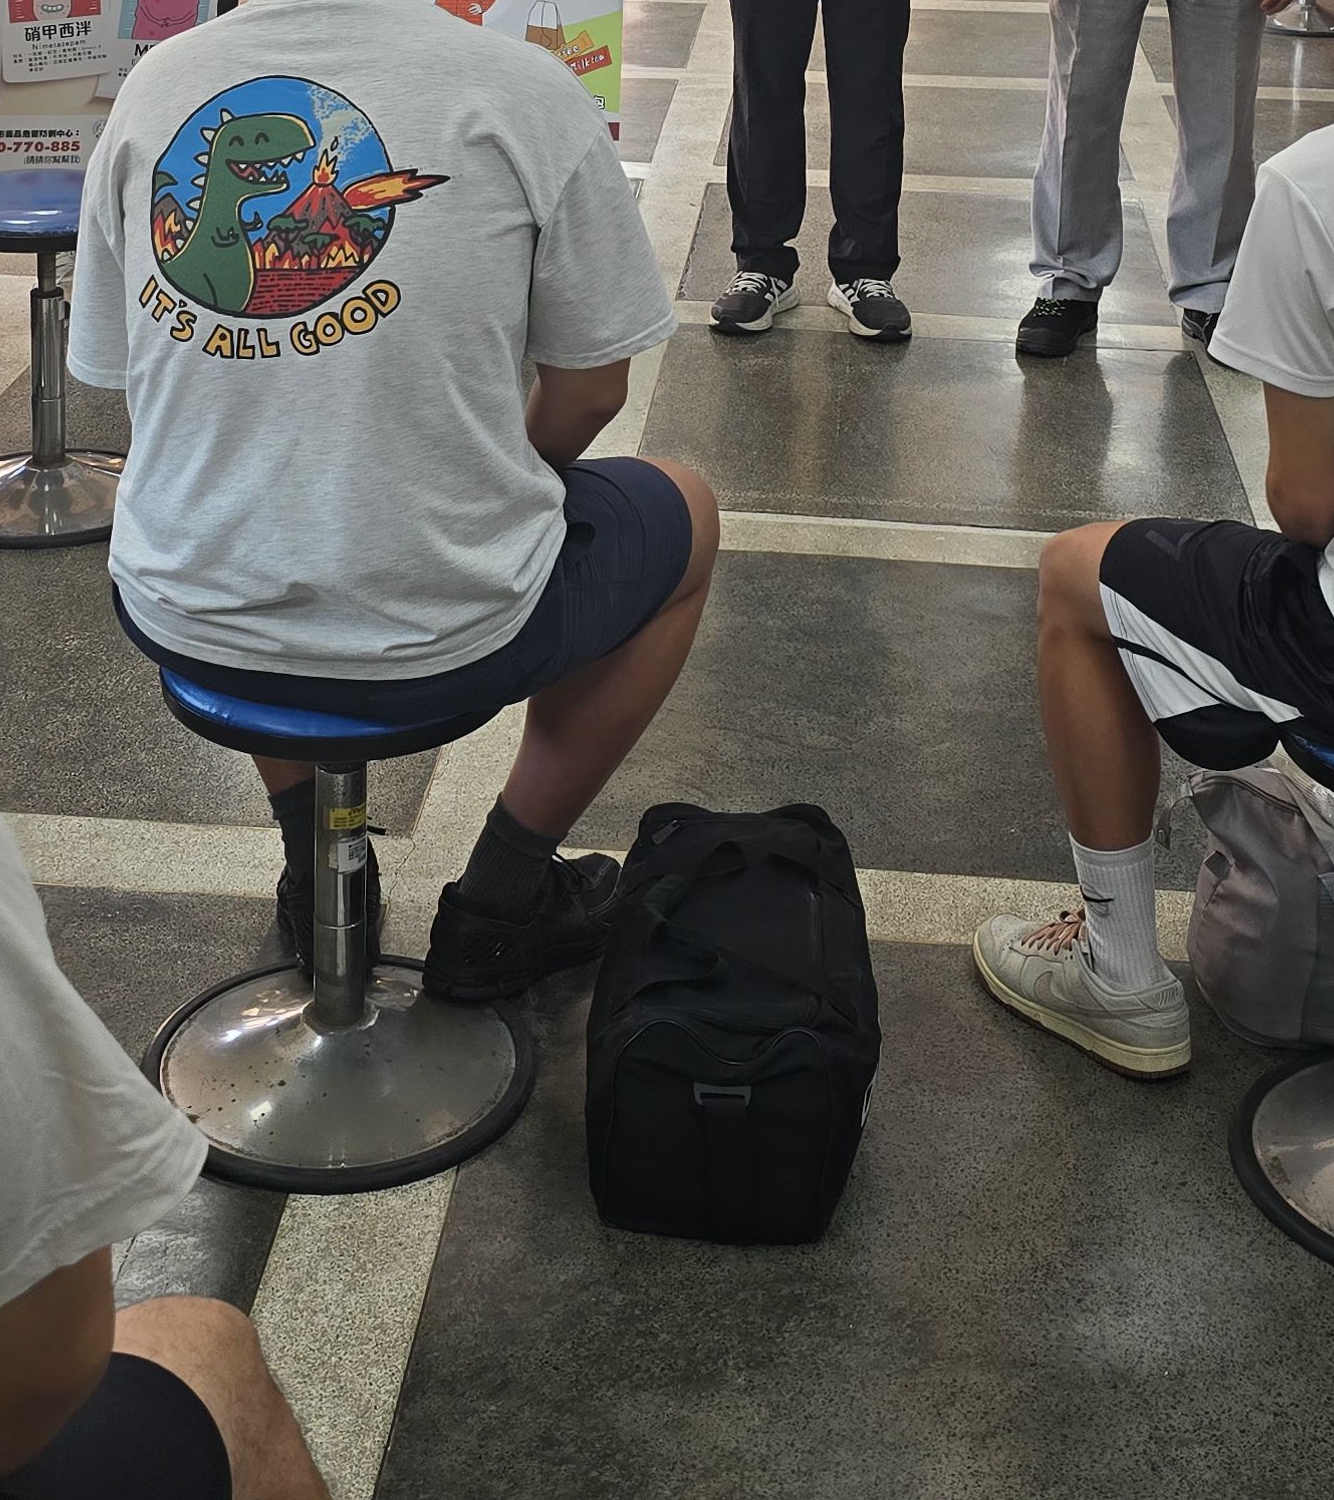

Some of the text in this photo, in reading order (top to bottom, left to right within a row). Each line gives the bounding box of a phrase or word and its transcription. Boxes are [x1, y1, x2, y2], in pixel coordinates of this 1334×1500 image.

[24, 20, 92, 42] 硝甲西泮
[31, 39, 87, 50] Nimetazepam
[138, 273, 403, 361] IT'S ALL GOOD
